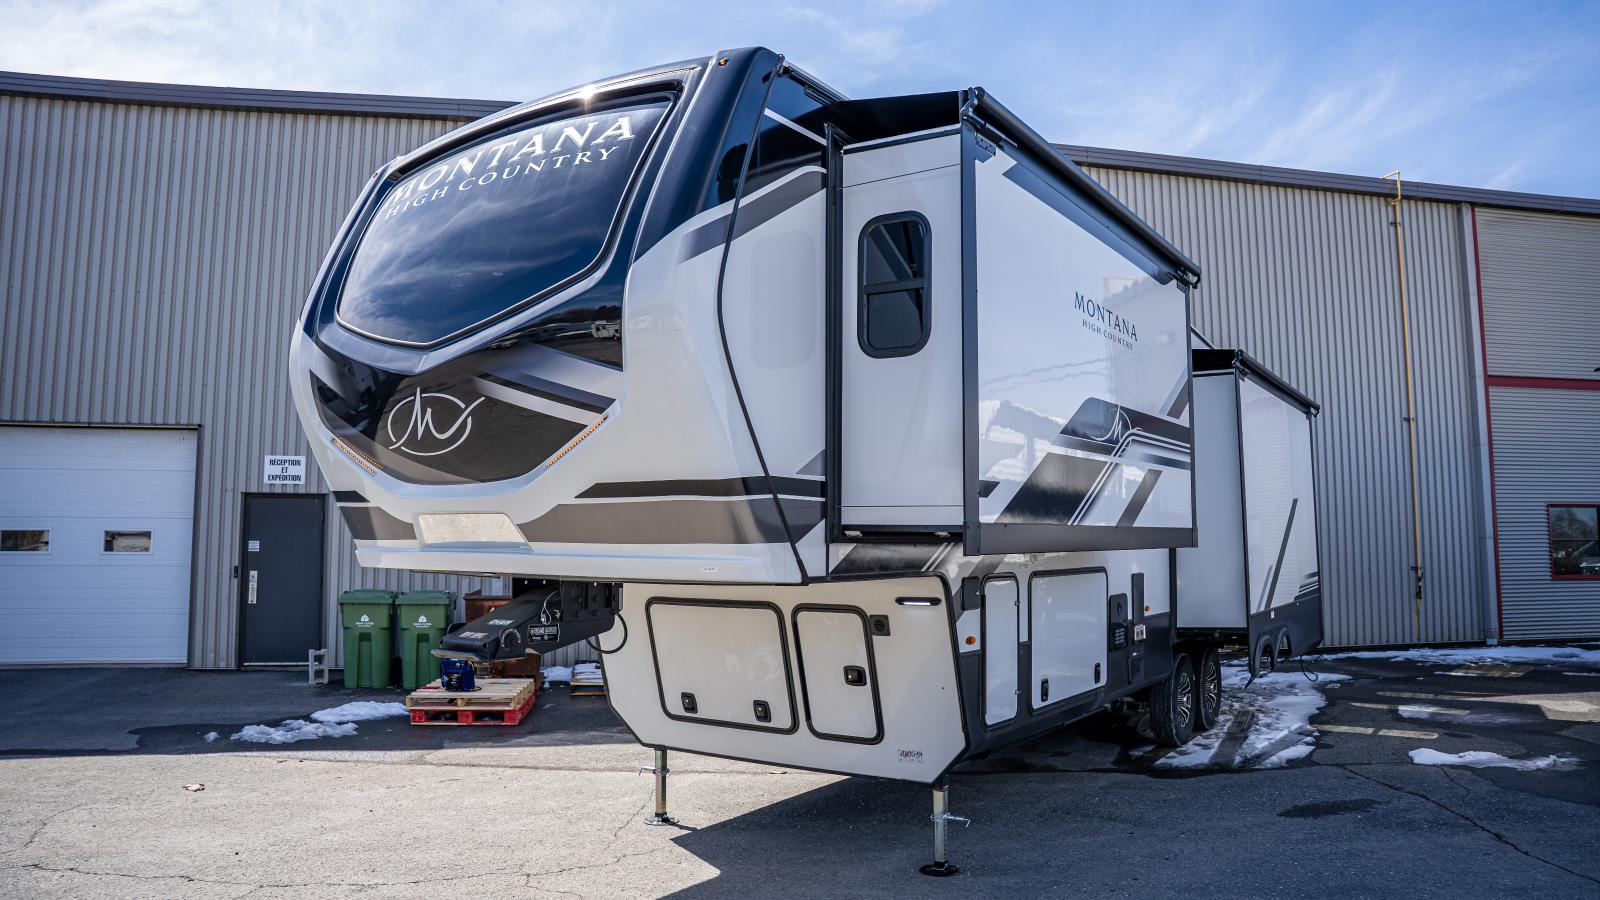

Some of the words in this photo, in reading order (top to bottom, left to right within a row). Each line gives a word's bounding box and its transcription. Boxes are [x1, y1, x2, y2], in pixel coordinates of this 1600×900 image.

[383, 116, 635, 208] MONTANA
[385, 185, 449, 218] HIGH
[458, 146, 618, 191] COUNTRY
[1074, 291, 1138, 342] MONTANA
[1082, 319, 1102, 335] HIGH
[1103, 330, 1133, 350] COUNTRY
[269, 458, 302, 466] RÉCEPTION
[281, 466, 288, 474] ET
[267, 474, 302, 482] EXPÉDITION
